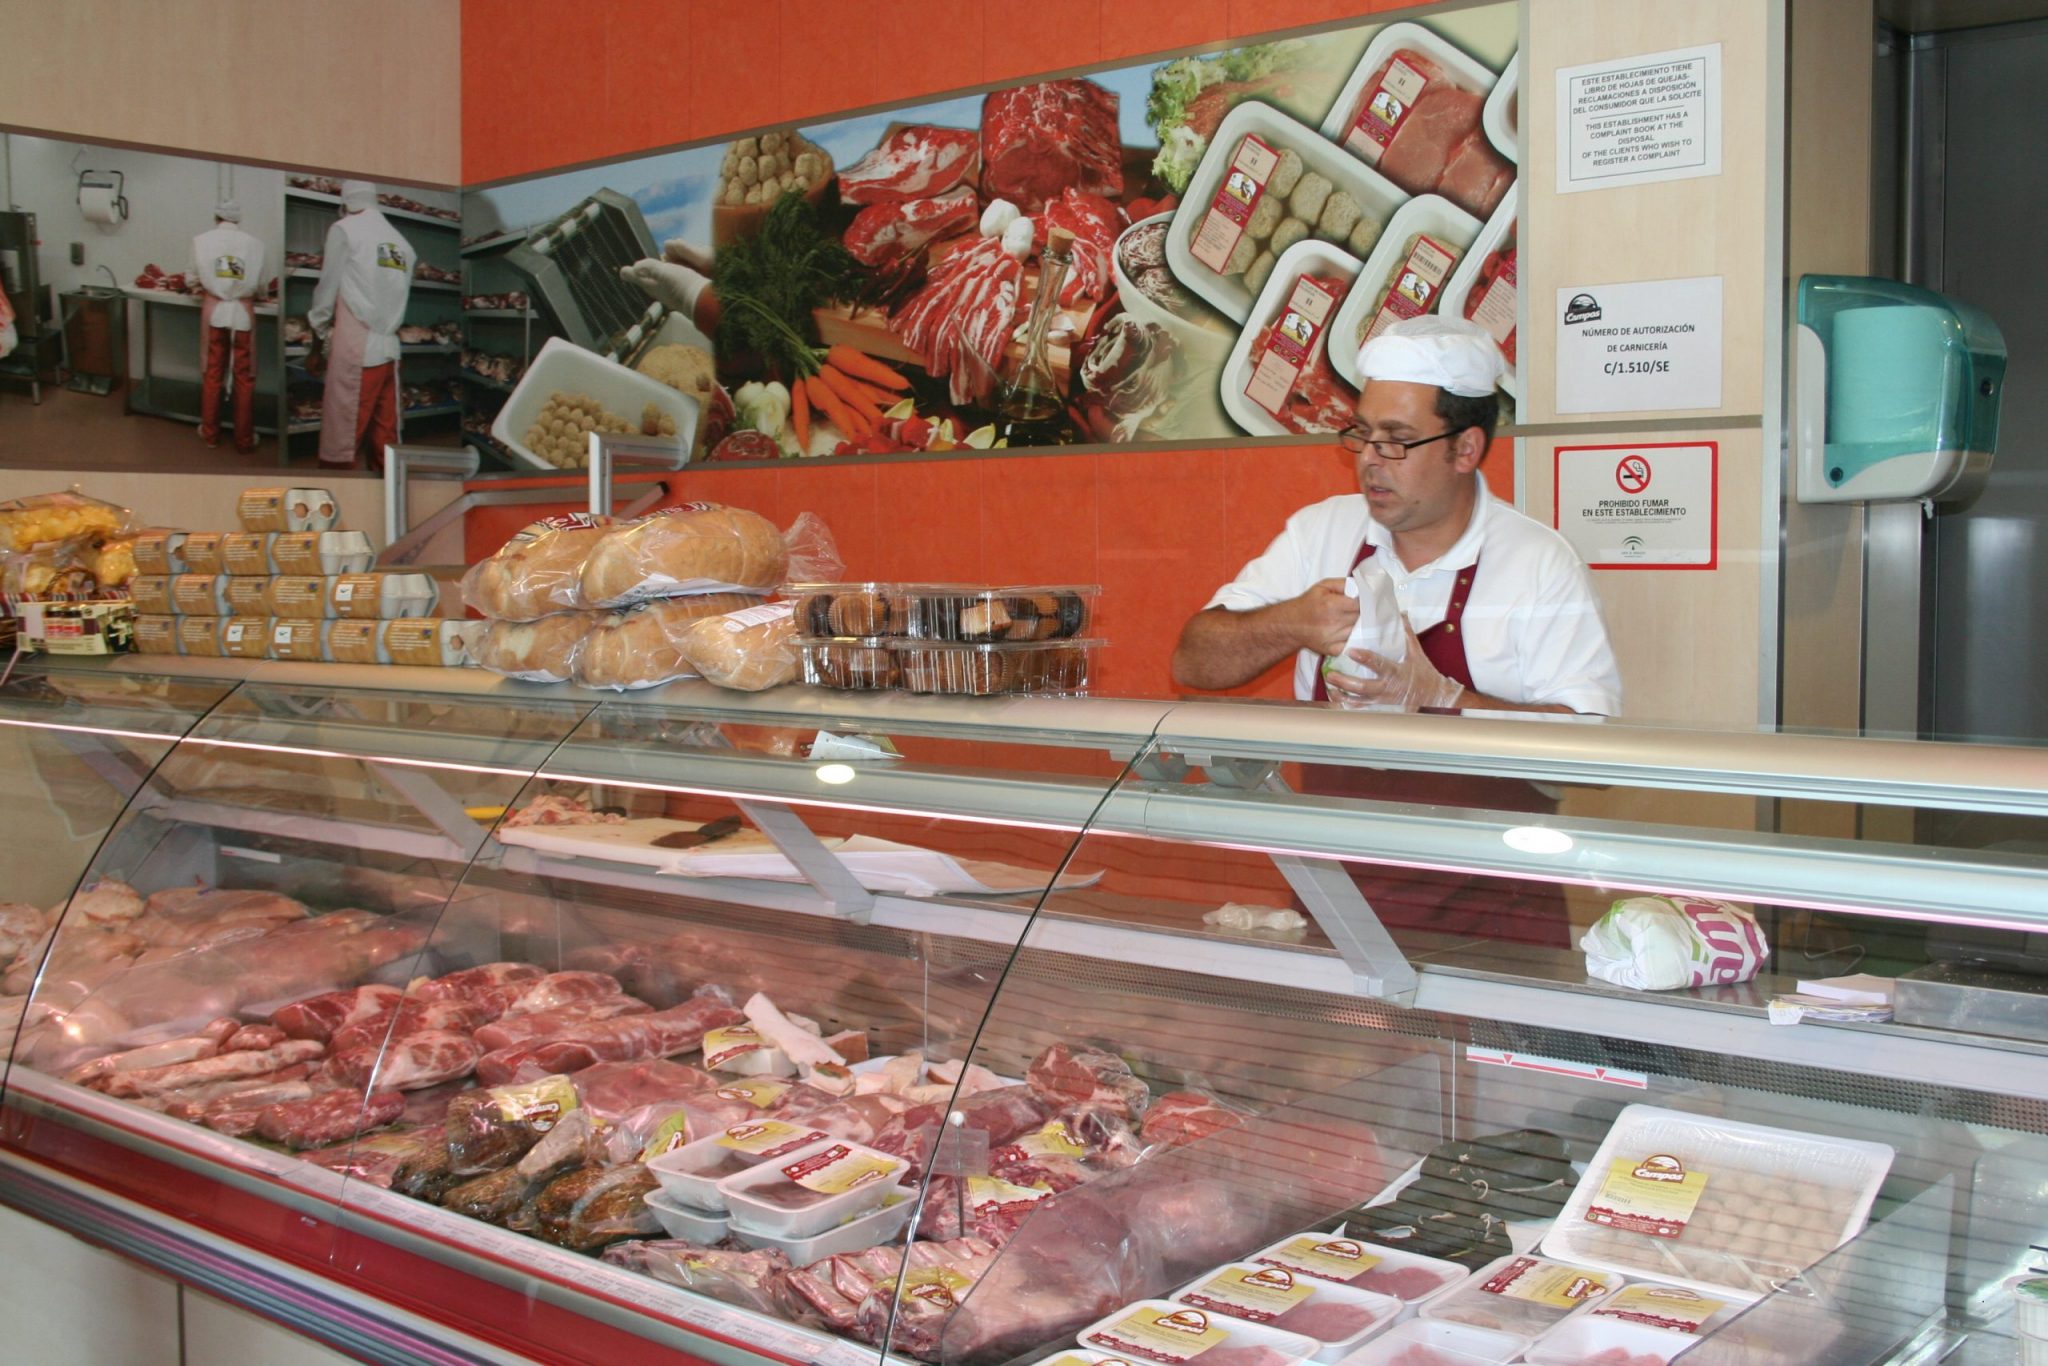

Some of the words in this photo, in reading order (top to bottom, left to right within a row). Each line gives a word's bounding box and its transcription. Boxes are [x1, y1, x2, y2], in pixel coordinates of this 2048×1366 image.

[1582, 78, 1599, 86] ESTE
[1602, 67, 1670, 83] ESTABLECIMIENTO
[1671, 63, 1692, 73] TIENE
[1584, 86, 1606, 94] LIBRO
[1620, 81, 1644, 90] HOJAS
[1646, 78, 1656, 86] DE
[1573, 106, 1586, 114] DEL
[1589, 98, 1637, 112] CONSUMIDOR
[1639, 96, 1654, 105] QUE
[1656, 94, 1666, 102] LA
[1668, 90, 1702, 101] SOLICITE
[1578, 88, 1640, 104] RECLAMACIONES
[1586, 123, 1601, 131] THIS
[1603, 114, 1664, 128] ESTABLISHMENT
[1666, 112, 1682, 121] HAS
[1590, 128, 1632, 140] COMPLAINT
[1634, 124, 1656, 134] BOOK
[1657, 123, 1667, 131] AT
[1594, 150, 1608, 158] THE
[1609, 145, 1640, 156] CLIENTS
[1642, 143, 1660, 152] WHO
[1661, 140, 1680, 148] WISH
[1682, 138, 1692, 146] TO
[1618, 135, 1655, 146] DISPOSAL
[1593, 156, 1628, 166] REGISTER
[1638, 150, 1680, 160] COMPLAINT
[1566, 311, 1601, 322] Campos
[1582, 326, 1619, 338] NÚMERO
[1620, 328, 1632, 336] DE
[1632, 323, 1696, 335] AUTORIZACIÓN
[1606, 344, 1618, 353] DE
[1620, 341, 1668, 352] CARNICERÍA
[1604, 360, 1670, 375] C/1.510/SE
[1598, 500, 1640, 508] PROHIBIDO
[1642, 499, 1669, 507] FUMAR
[1582, 508, 1593, 517] EN
[1595, 508, 1614, 516] ESTE
[1616, 508, 1686, 516] ESTABLECIMIENTO
[1633, 1168, 1684, 1181] Campos
[1156, 1319, 1206, 1334] Campos
